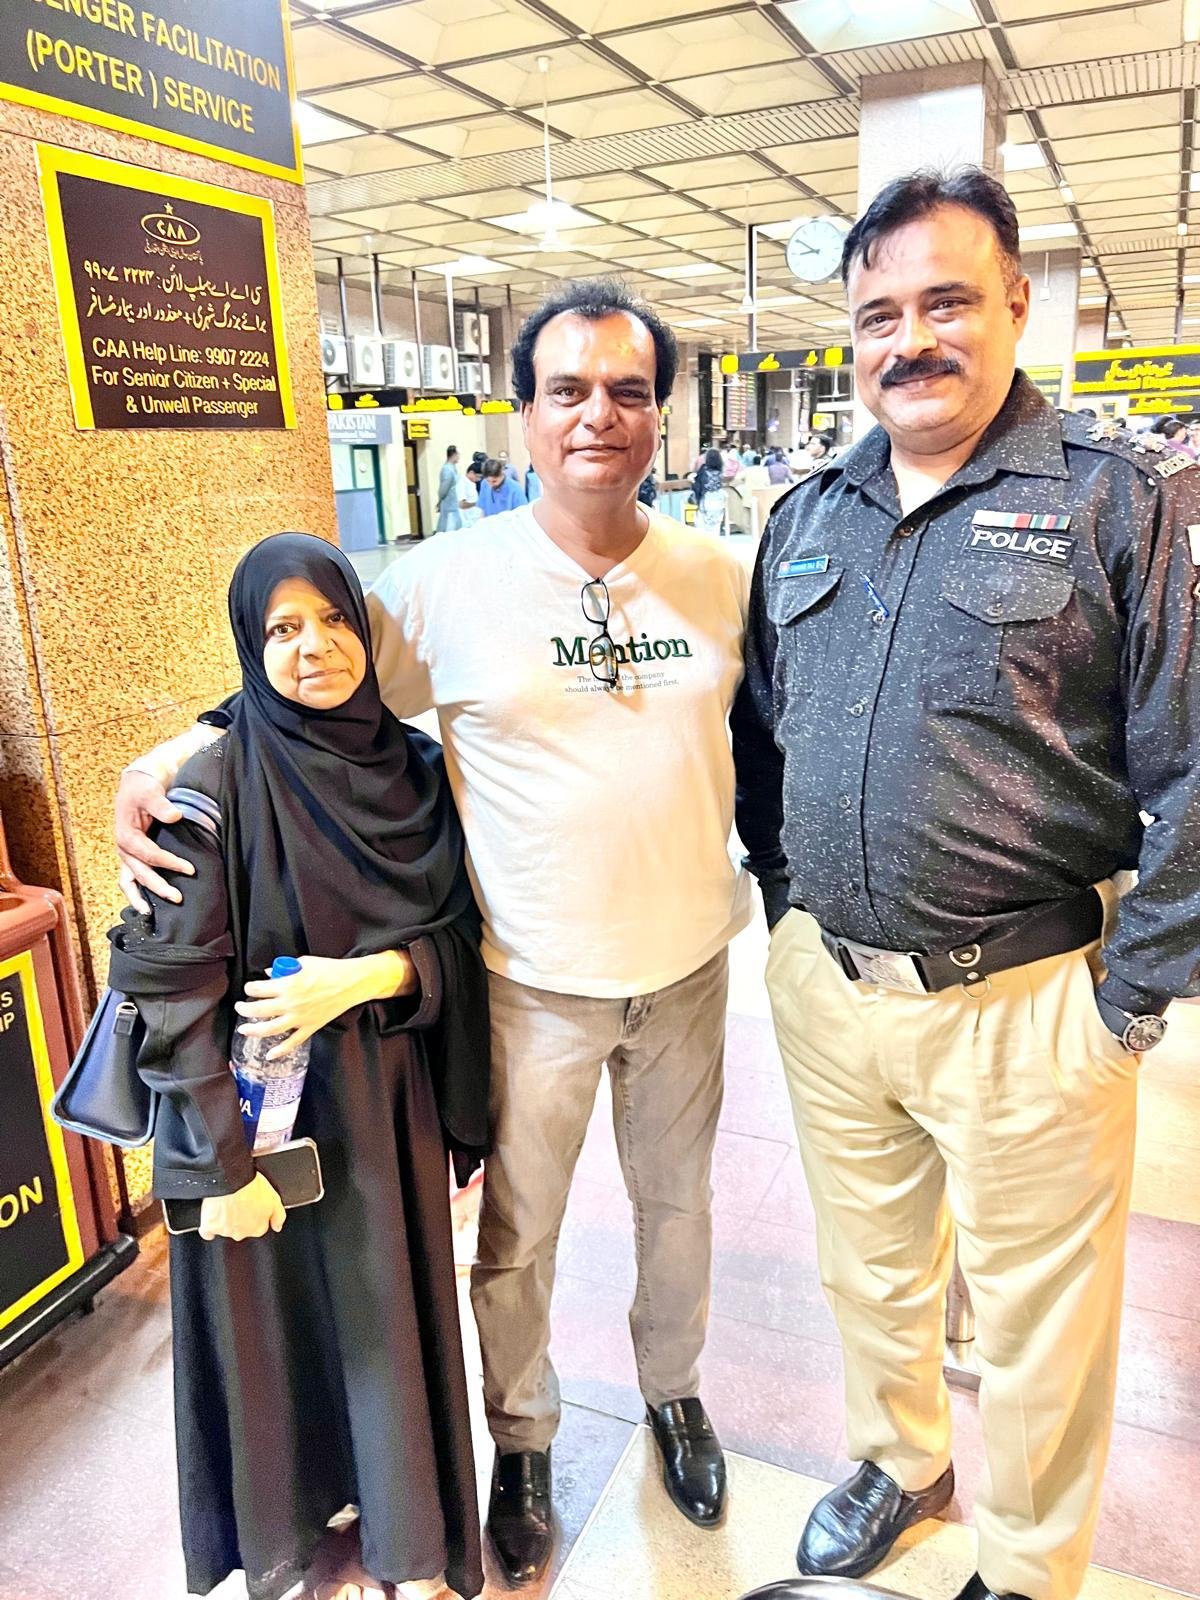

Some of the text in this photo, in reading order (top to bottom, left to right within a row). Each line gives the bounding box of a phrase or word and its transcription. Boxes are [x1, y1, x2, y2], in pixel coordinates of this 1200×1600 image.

[142, 11, 280, 92] FACILITATION
[26, 29, 145, 98] (PORTER
[163, 76, 255, 133] SERVICE
[156, 219, 188, 241] CAA
[136, 301, 152, 320] اور
[92, 336, 270, 368] CAA Help Line: 9907 2224
[91, 365, 277, 394] For Senior Citizen + Special
[126, 394, 259, 419] & Unwell Passenger
[971, 529, 1072, 560] POLICE
[550, 632, 693, 667] Mention
[565, 685, 588, 693] should
[590, 684, 614, 693] alway
[626, 680, 662, 691] mentioned
[634, 672, 665, 682] company
